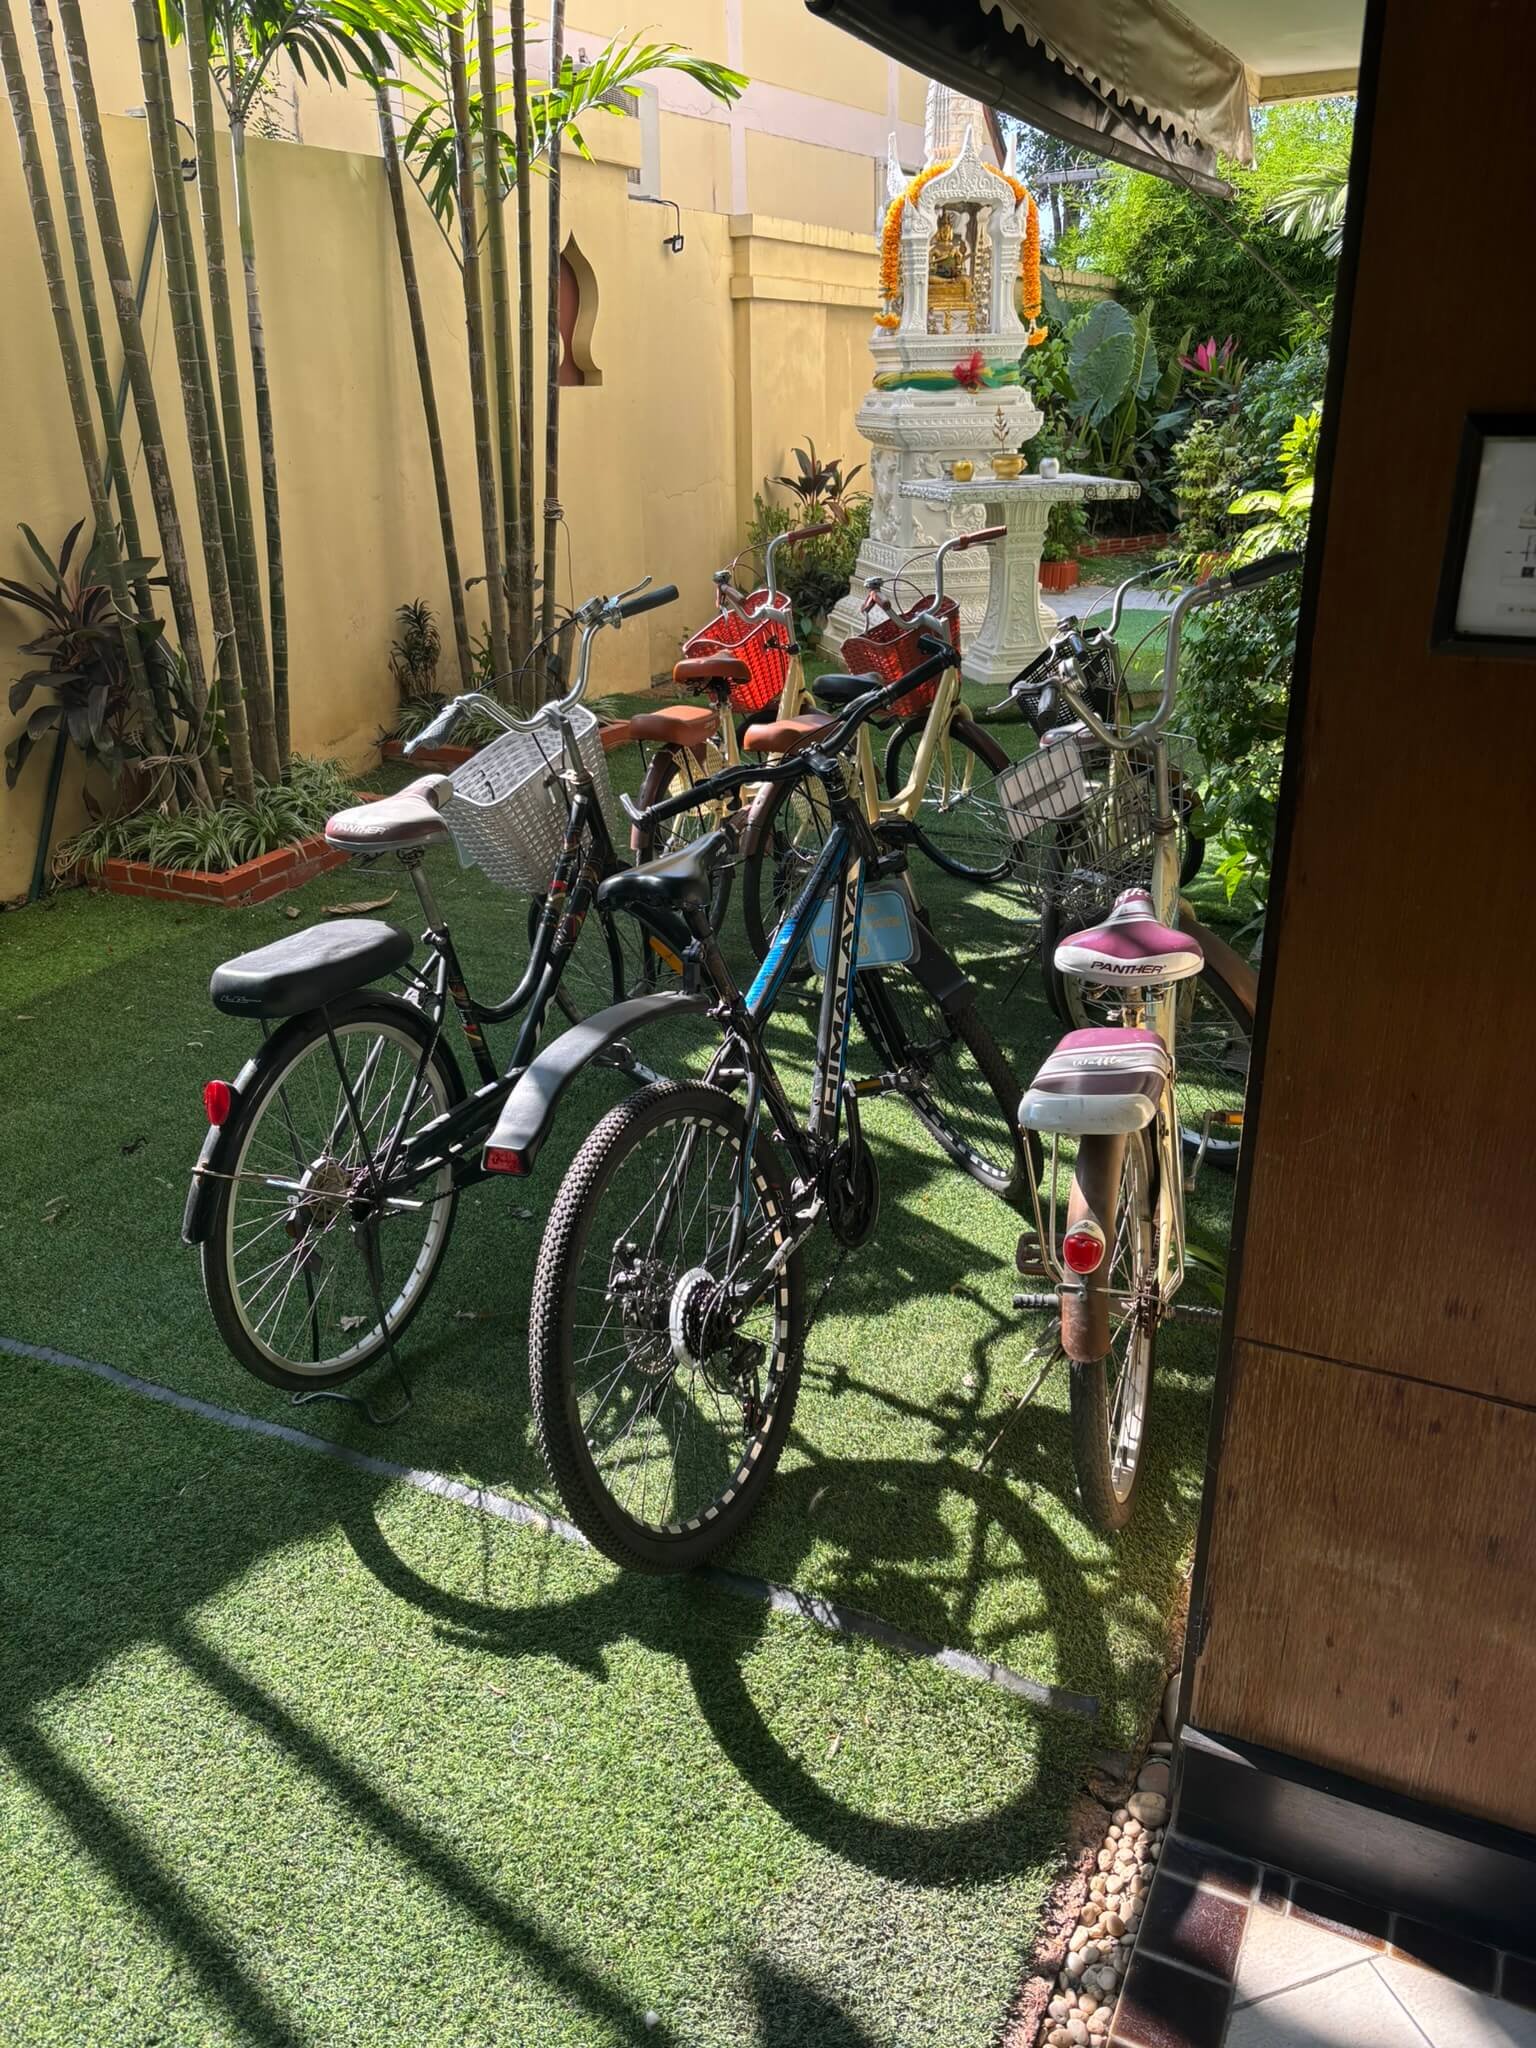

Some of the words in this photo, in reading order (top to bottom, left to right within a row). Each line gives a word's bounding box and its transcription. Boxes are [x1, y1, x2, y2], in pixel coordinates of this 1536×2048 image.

[333, 823, 387, 835] PANTHER
[1090, 961, 1164, 974] PANTHER
[824, 878, 857, 1113] HIMALAYA
